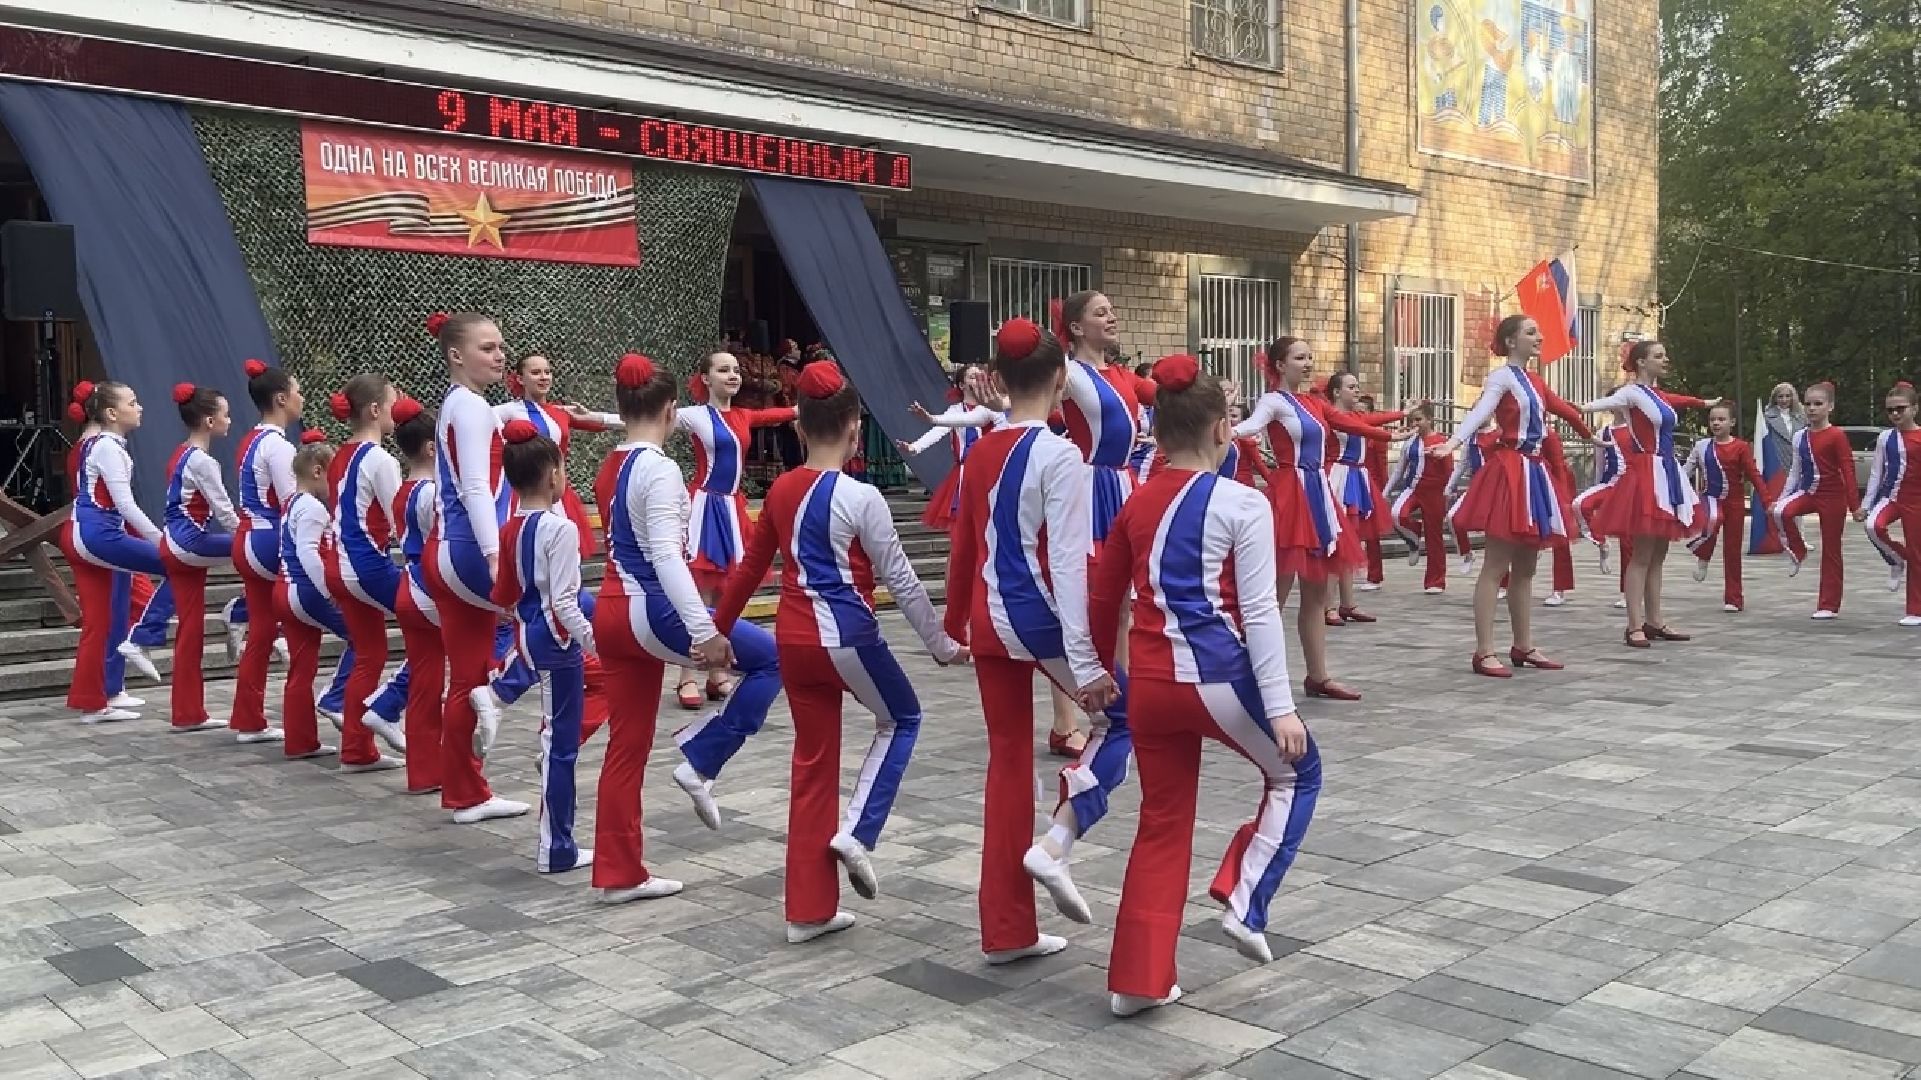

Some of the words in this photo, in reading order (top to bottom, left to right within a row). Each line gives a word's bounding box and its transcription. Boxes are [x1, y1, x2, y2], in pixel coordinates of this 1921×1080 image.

[320, 142, 375, 175] ОДНА
[382, 149, 409, 179] НА
[414, 153, 462, 184] ВСЕХ
[469, 160, 549, 193] ВЕЛИКАЯ
[554, 168, 618, 201] ПОБЕДА
[438, 91, 466, 132] 9
[489, 96, 577, 146] МАЯ
[641, 120, 875, 184] СВЯЩЕННЫЙ
